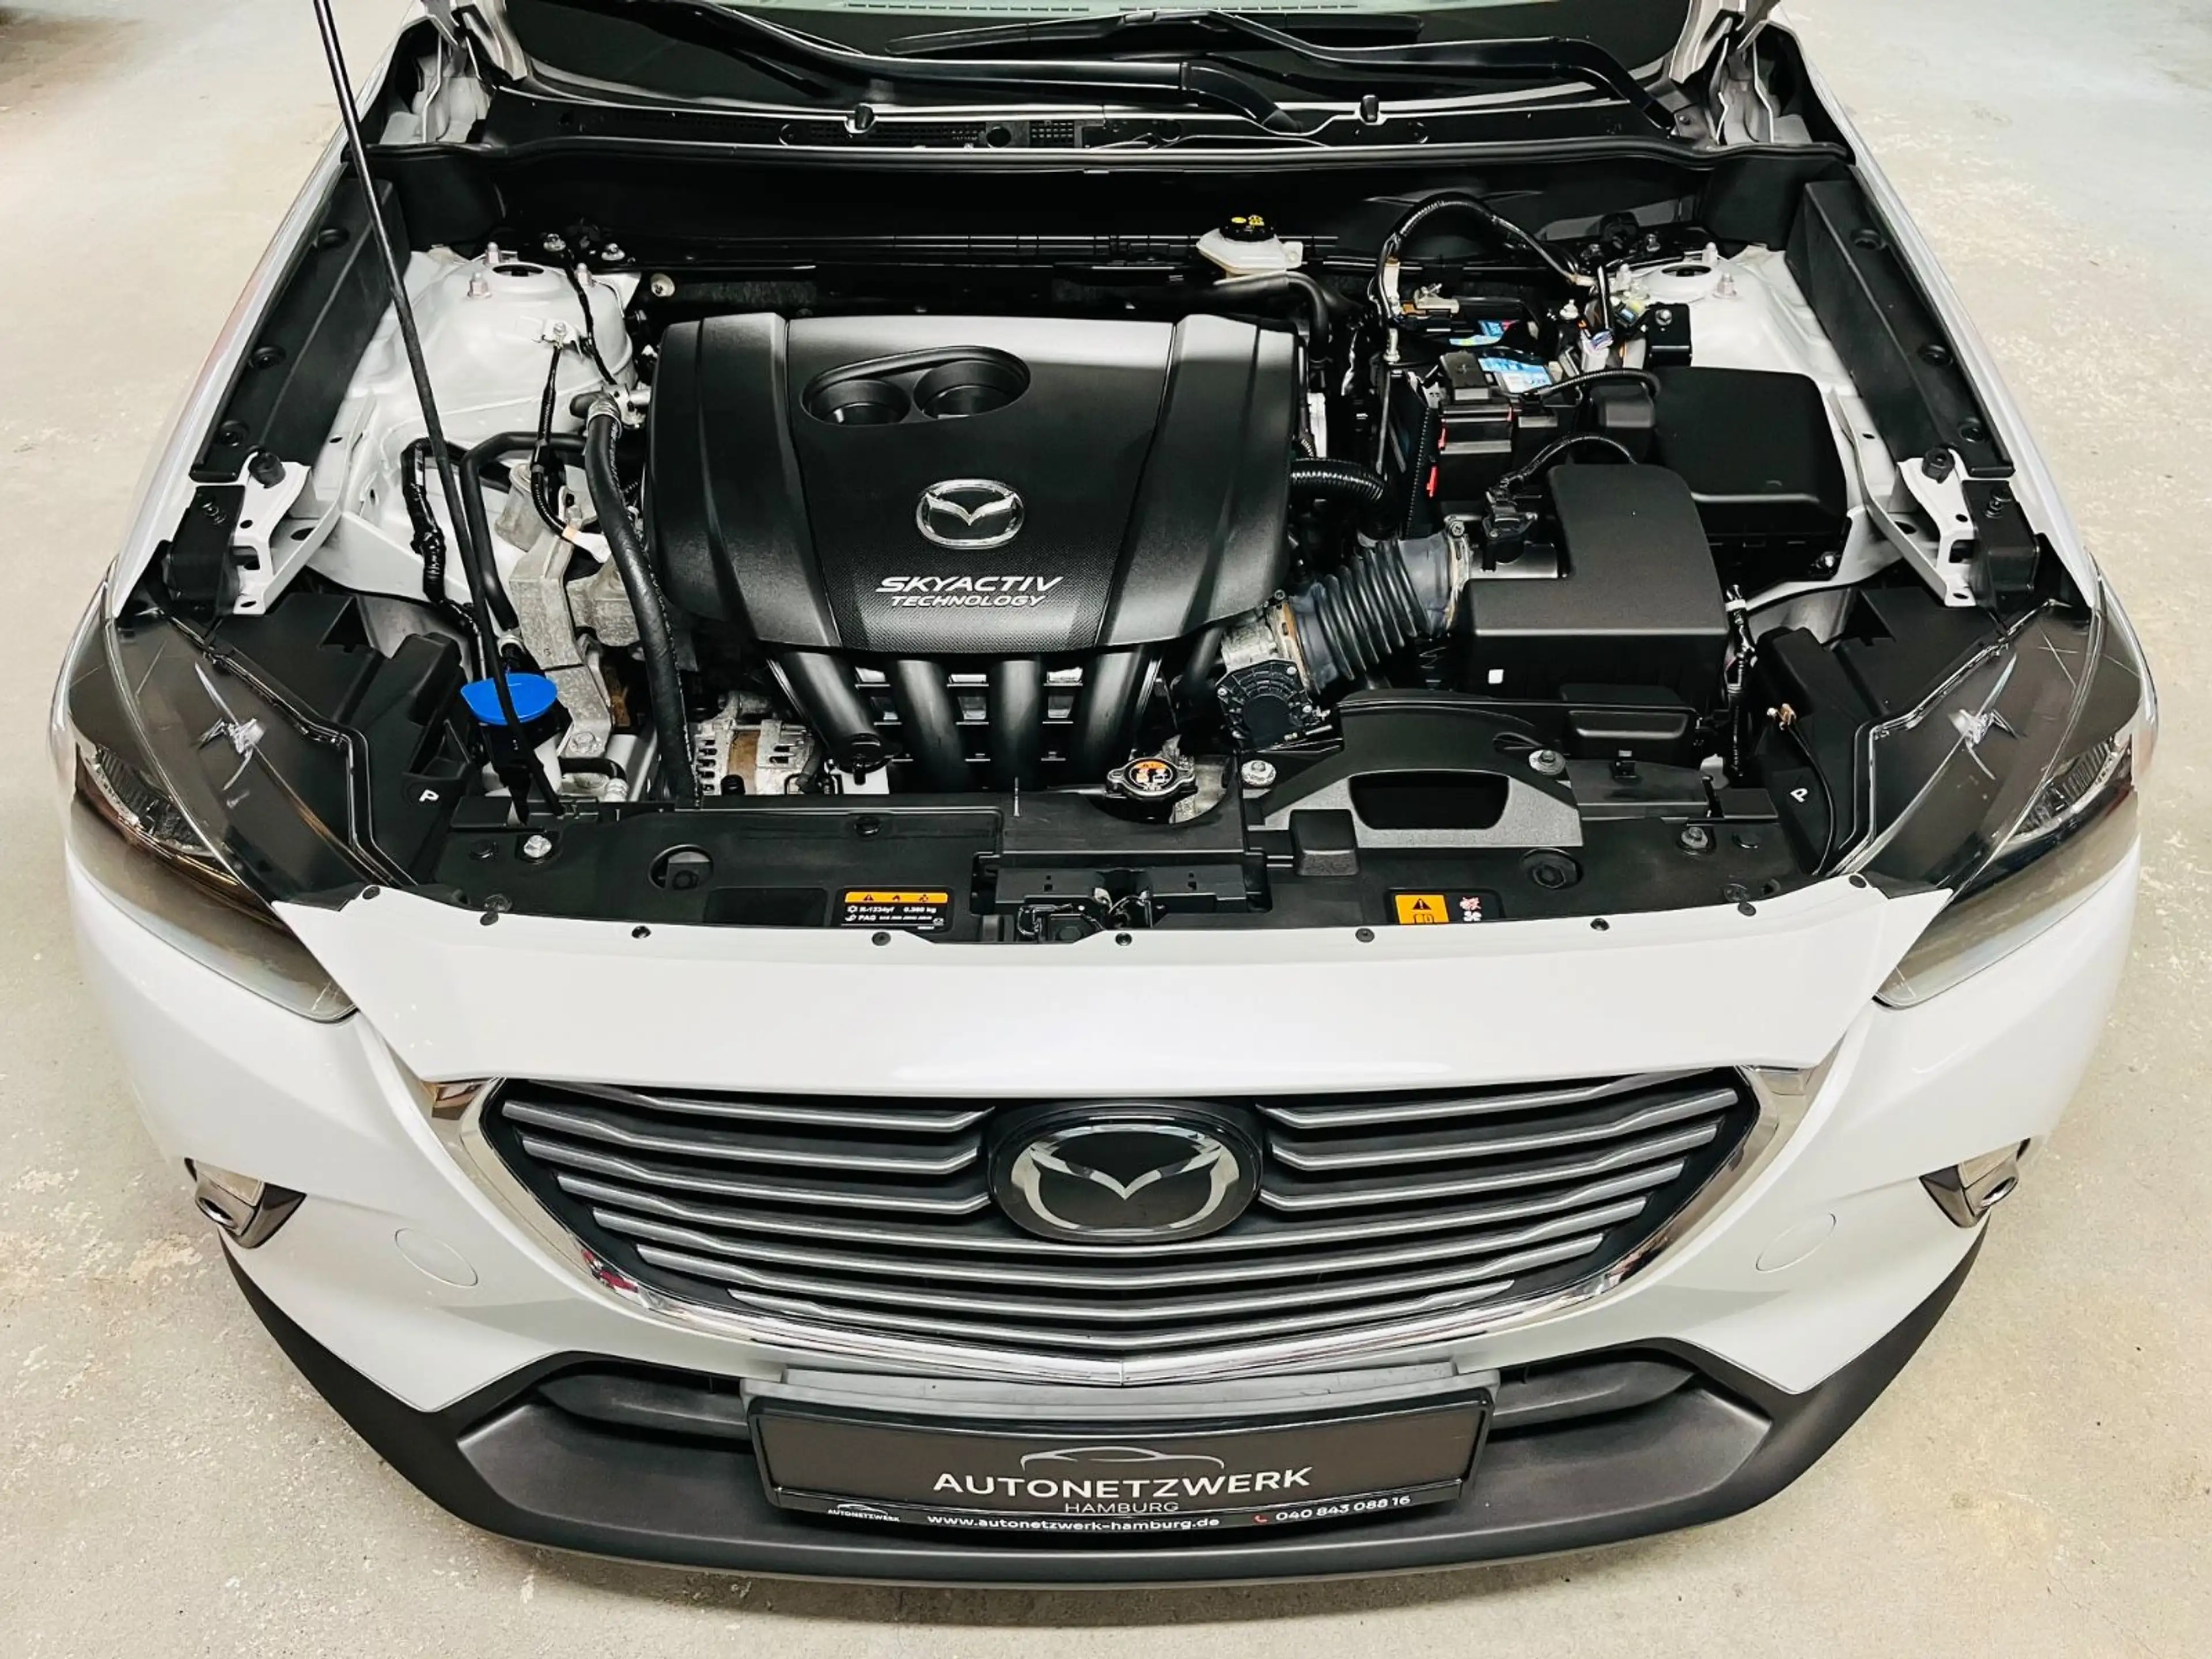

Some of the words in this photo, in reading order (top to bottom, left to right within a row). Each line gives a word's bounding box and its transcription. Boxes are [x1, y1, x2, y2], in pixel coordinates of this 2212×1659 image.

[875, 576, 1064, 592] SKYACTIV
[891, 596, 1046, 608] TECHNOLOGY
[419, 789, 439, 802] P
[1790, 788, 1808, 802] P
[933, 1467, 1313, 1499] AUTONETZWERK
[1065, 1502, 1180, 1513] HAMBURG
[1275, 1509, 1313, 1521] 040
[1316, 1504, 1350, 1516] 843
[1353, 1499, 1388, 1512] 088
[1392, 1495, 1411, 1506] 16
[827, 1509, 900, 1522] AUTONETZWERK
[927, 1516, 1220, 1531] www.autonetzwerk-hamburg.de
